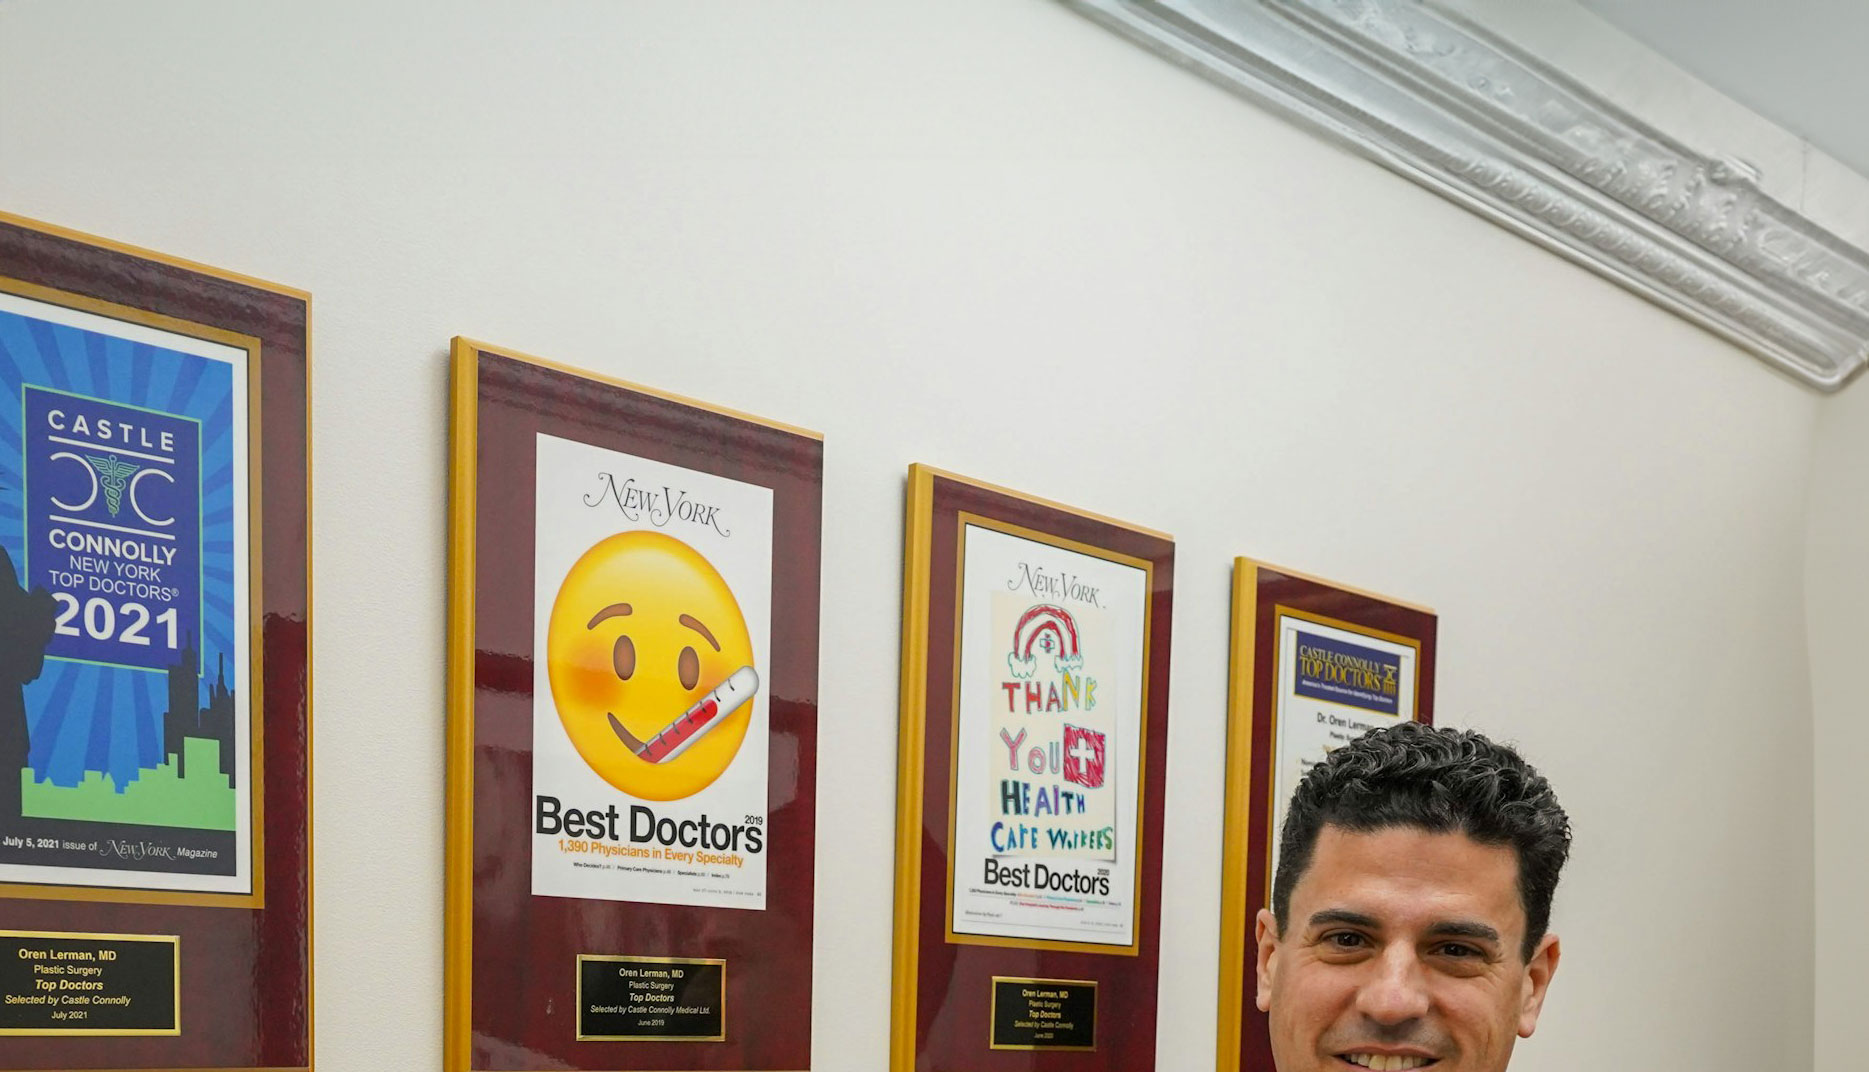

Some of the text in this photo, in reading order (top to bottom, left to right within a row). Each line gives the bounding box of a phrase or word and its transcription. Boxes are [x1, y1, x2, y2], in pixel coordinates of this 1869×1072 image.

[48, 409, 174, 451] CASTLE
[583, 472, 731, 538] NEW YORK
[49, 528, 176, 565] CONNOLLY
[70, 555, 161, 582] NEW YORK
[49, 570, 84, 588] TOP
[51, 591, 178, 649] 2021
[1300, 645, 1380, 674] CASTLE CONNOLLY
[1300, 655, 1381, 691] TOP DOCTORS
[1002, 669, 1097, 714] THANK
[1329, 715, 1346, 727] Oren
[536, 794, 763, 854] Best Doctors
[744, 814, 764, 826] 2019
[3, 836, 24, 848] July
[26, 838, 35, 848] 5,
[37, 838, 59, 849] 2021
[62, 839, 87, 850] issue
[88, 841, 97, 850] of
[176, 847, 218, 859] Magazine
[558, 838, 744, 868] 1,390 Physicians in Every Specialty
[984, 858, 1110, 896] Best Doctors
[18, 948, 117, 962] Oren Lerman, MD
[34, 964, 102, 977] Plastic Surgery
[619, 968, 684, 979] Oren Lerman, MD
[35, 979, 104, 992] Top Doctors
[629, 981, 674, 991] Plastic Surgery
[5, 994, 131, 1007] Selected by Castle Connolly
[629, 992, 675, 1003] Top Doctors
[51, 1011, 88, 1020] July 2021
[590, 1004, 618, 1013] Selected
[618, 1005, 627, 1015] by
[627, 1005, 647, 1013] Castle
[648, 1005, 675, 1015] Connolly
[676, 1006, 699, 1014] Medical
[1029, 1010, 1039, 1019] Top
